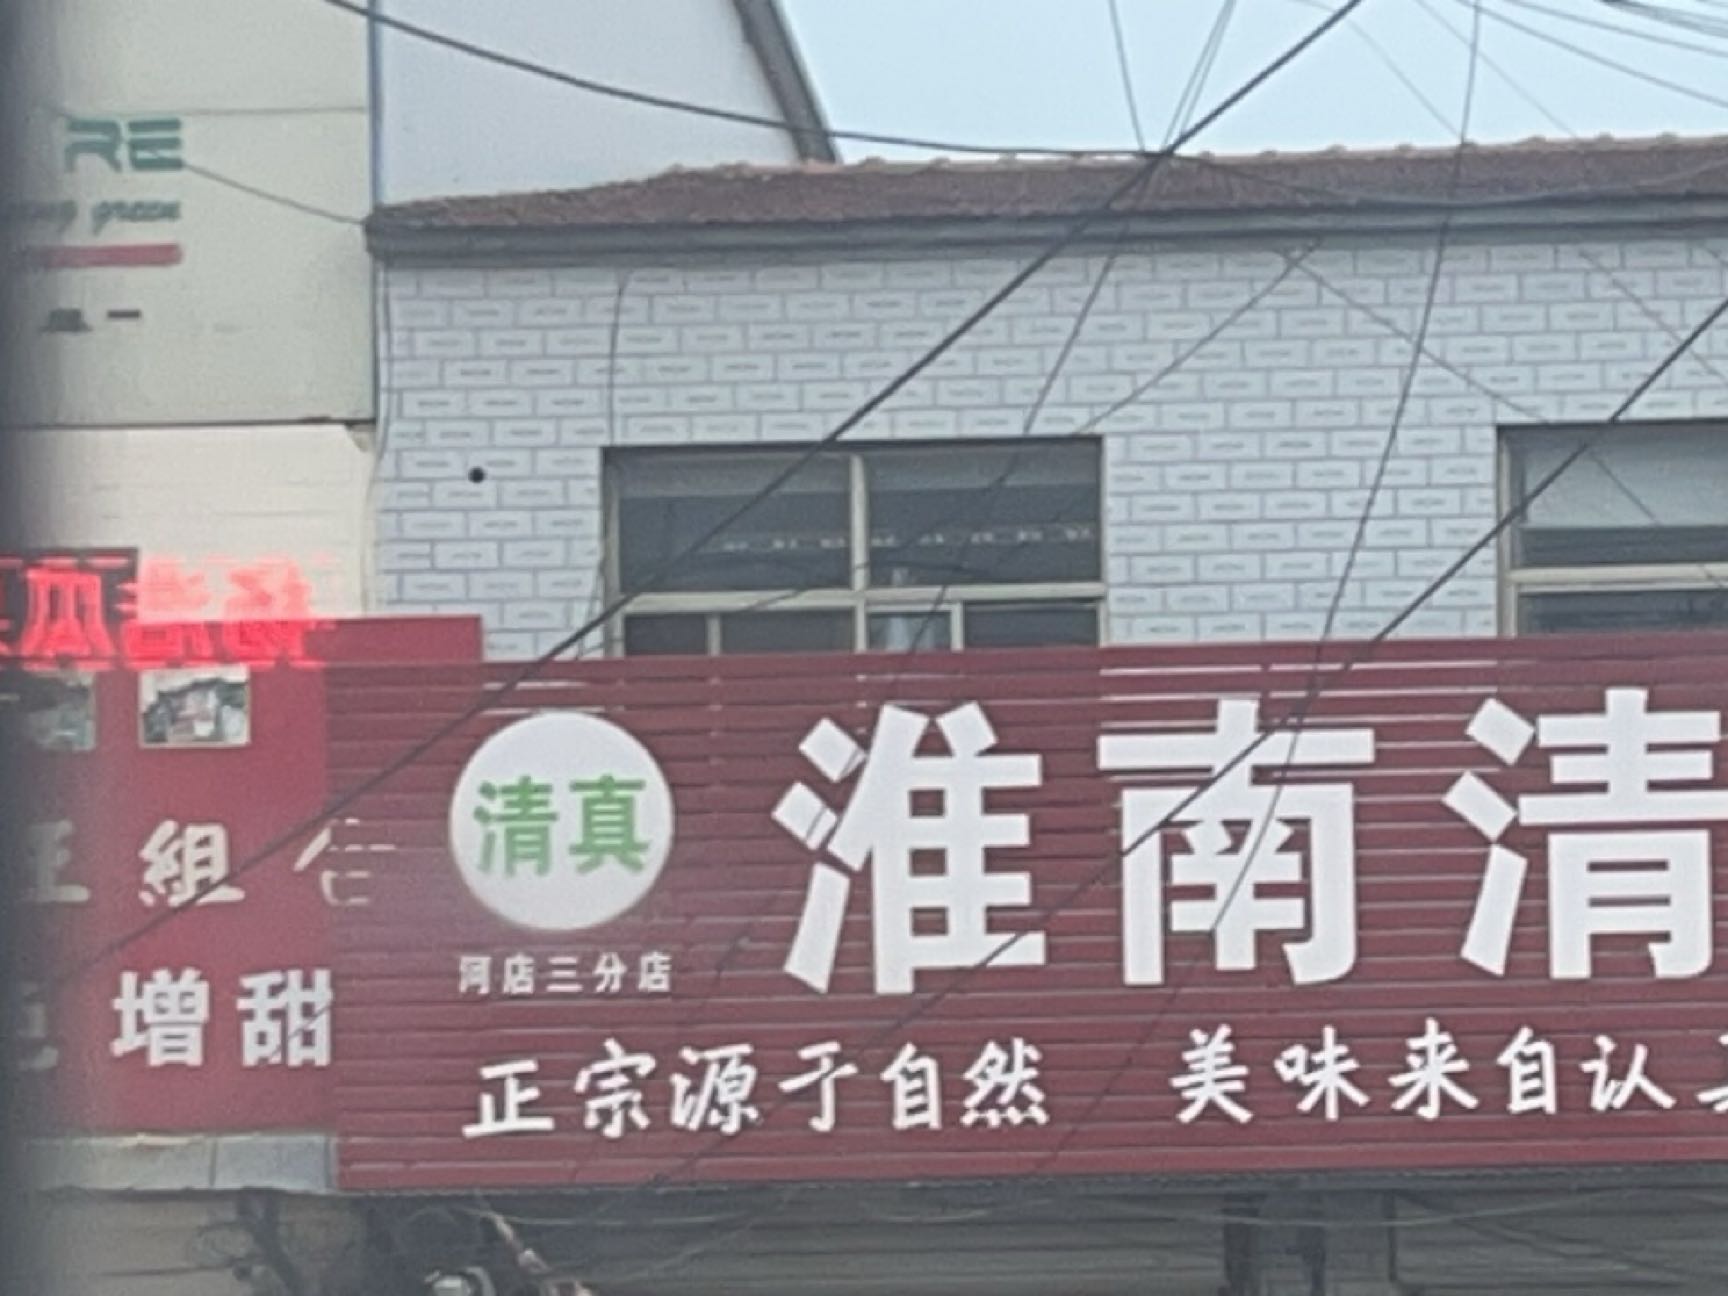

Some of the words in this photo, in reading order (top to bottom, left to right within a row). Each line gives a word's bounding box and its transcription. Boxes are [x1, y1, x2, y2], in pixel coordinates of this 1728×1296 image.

[474, 774, 651, 878] 清真
[462, 1037, 1050, 1139] 正宗源于自然
